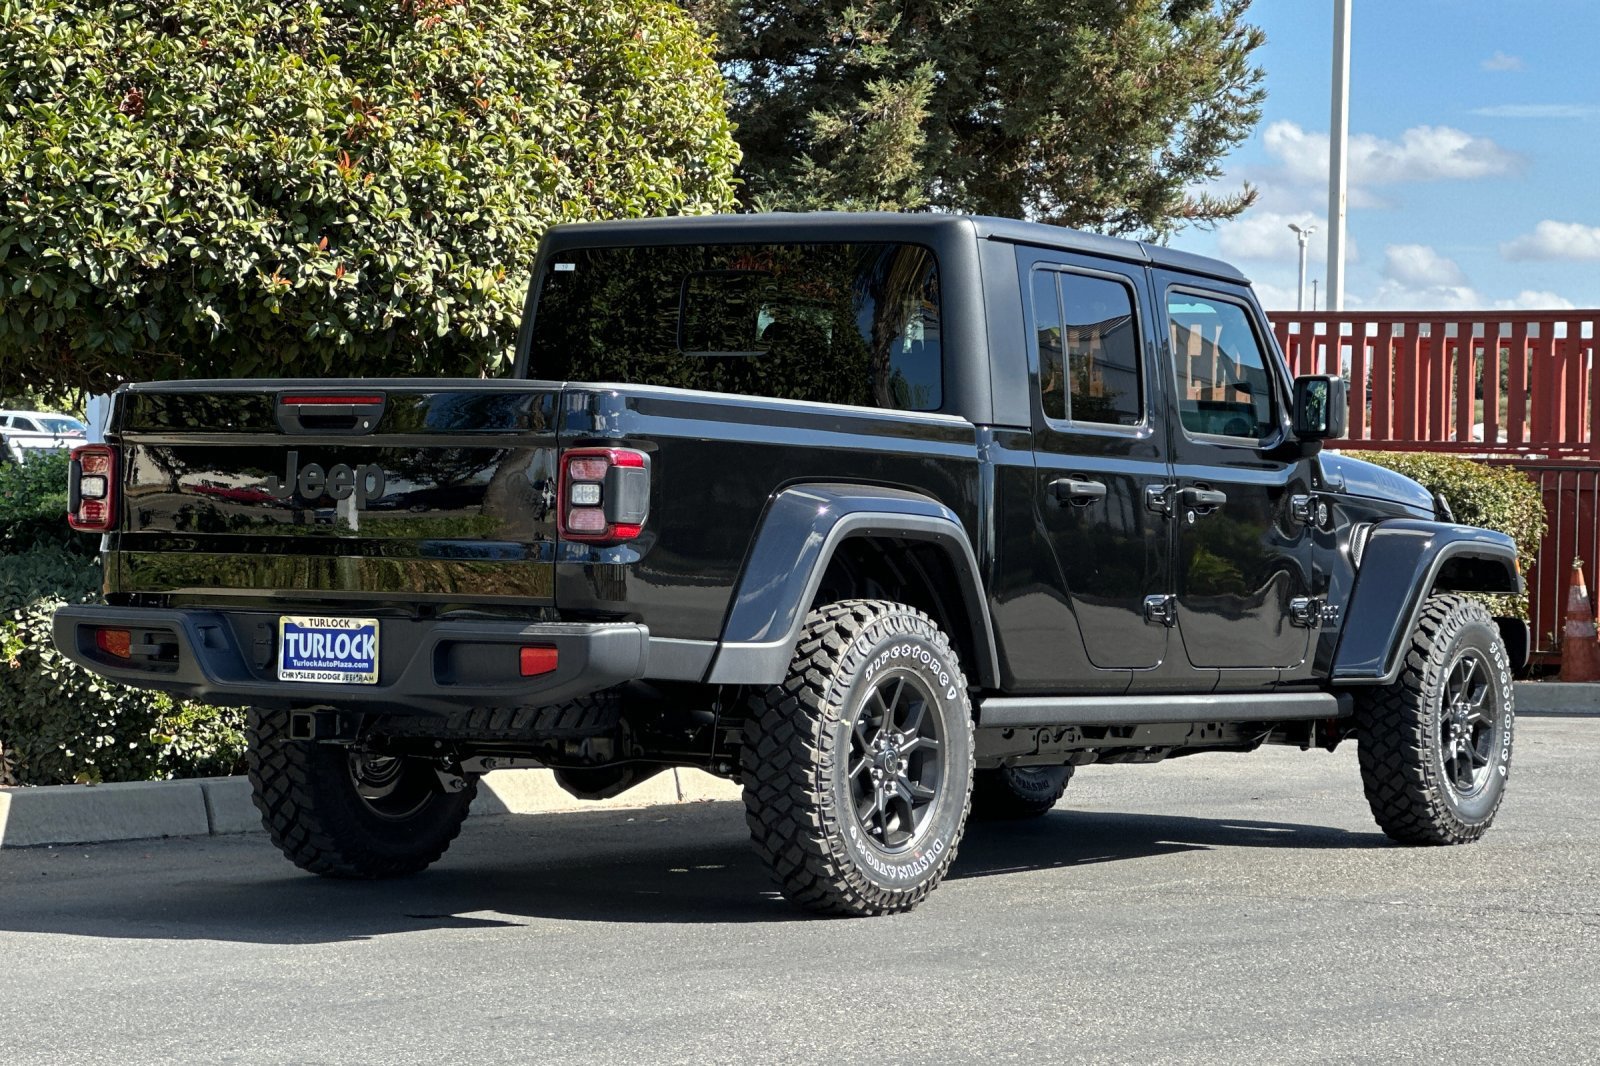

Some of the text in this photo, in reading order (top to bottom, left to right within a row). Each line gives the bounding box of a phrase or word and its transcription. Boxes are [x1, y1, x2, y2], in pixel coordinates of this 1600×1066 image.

[267, 450, 385, 510] Jeep
[309, 618, 350, 628] TURLOCK
[286, 633, 376, 660] TURLOCK
[282, 671, 316, 680] CHRYSLER
[317, 672, 341, 681] DODGE
[358, 674, 374, 682] RAM
[293, 659, 369, 669] TurlockAutoPlaza.com
[865, 644, 949, 686] Firestone
[856, 838, 944, 879] DESTINATION
